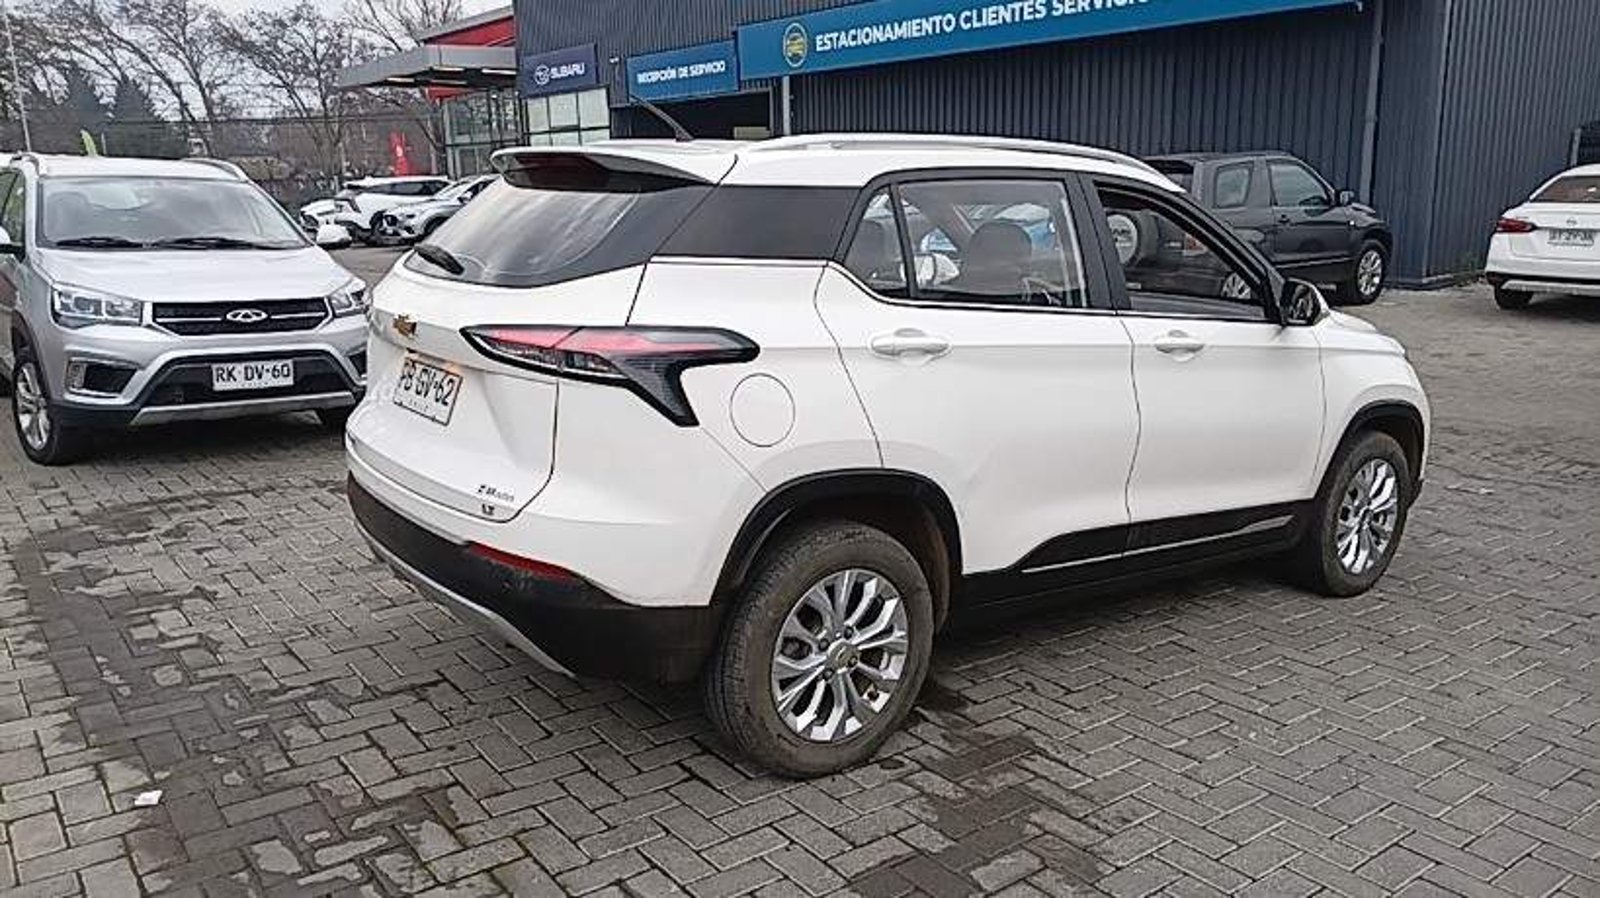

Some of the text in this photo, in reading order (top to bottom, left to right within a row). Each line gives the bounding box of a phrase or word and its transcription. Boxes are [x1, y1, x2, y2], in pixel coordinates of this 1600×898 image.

[815, 13, 956, 51] ESTACIONAMIENTO
[959, 2, 1047, 30] CLIENTES
[550, 62, 585, 80] SUBARU
[678, 66, 688, 79] DE
[689, 60, 726, 77] SERVICIO
[215, 366, 237, 383] RK
